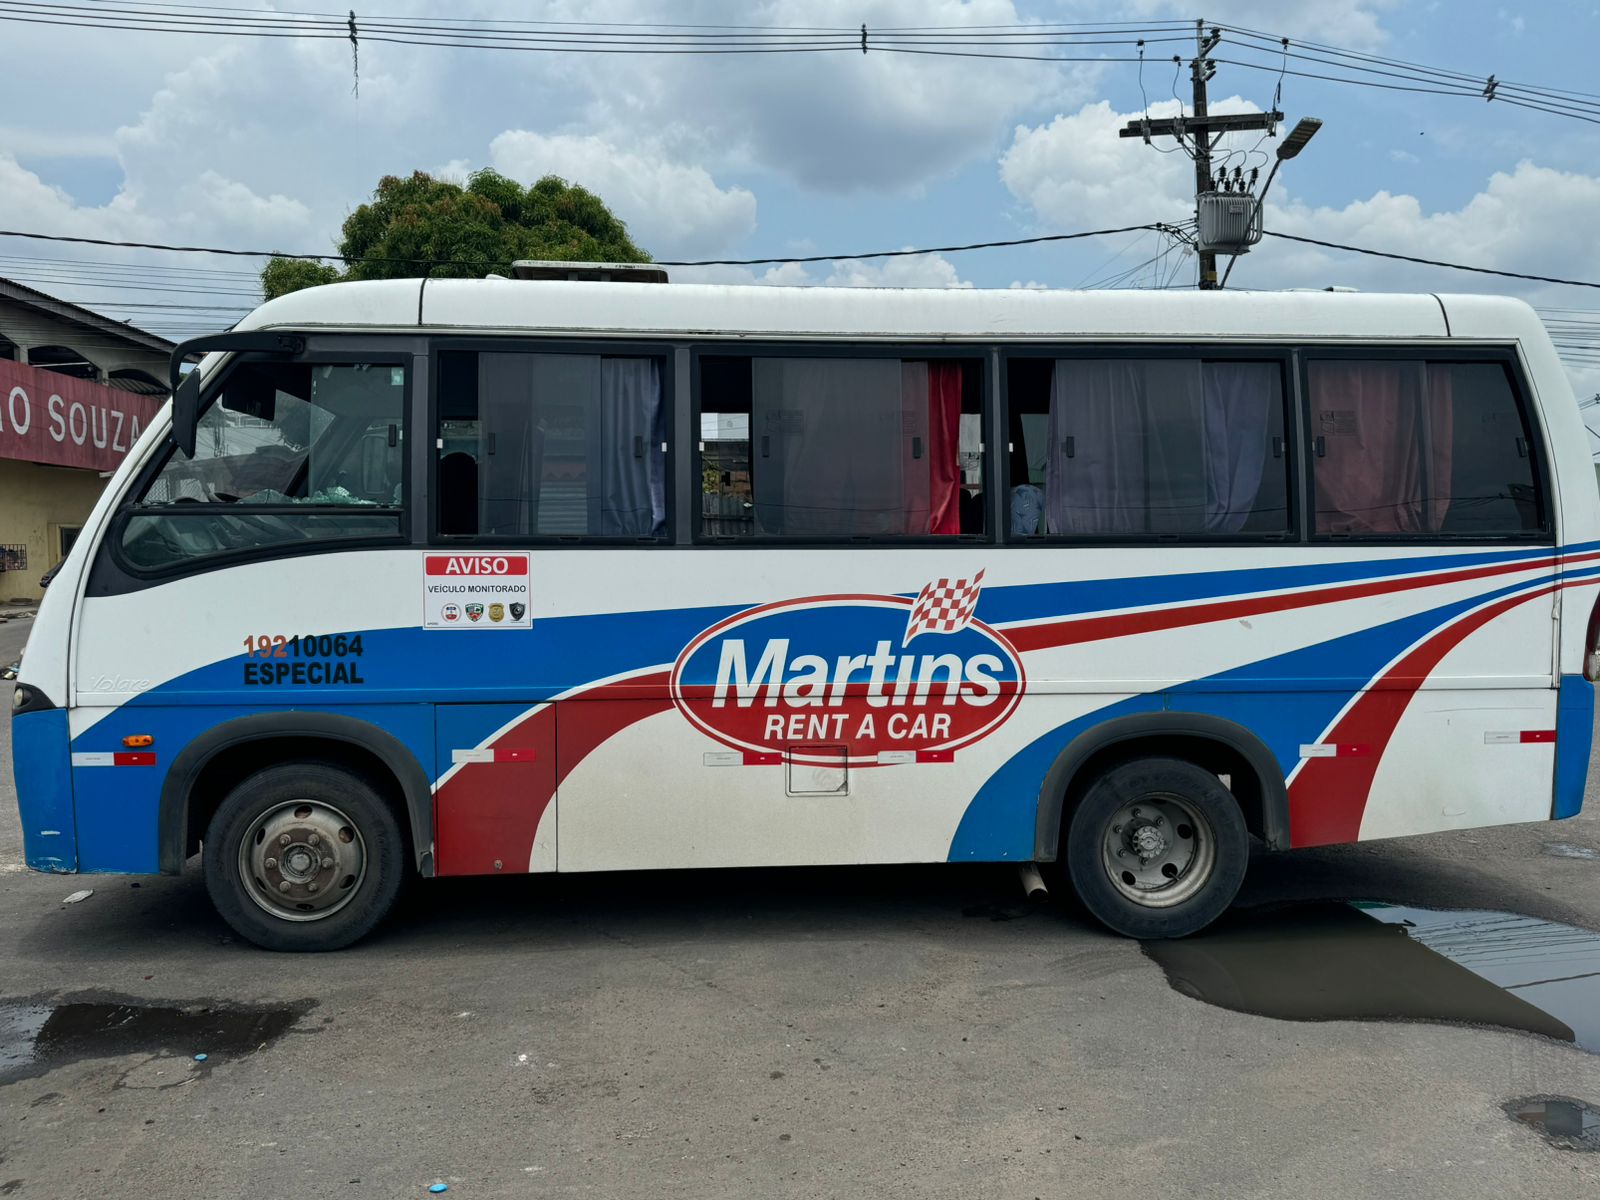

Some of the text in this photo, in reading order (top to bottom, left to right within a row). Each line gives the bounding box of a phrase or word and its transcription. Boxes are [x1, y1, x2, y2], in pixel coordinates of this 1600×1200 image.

[0, 386, 140, 452] O SOUZA
[445, 557, 509, 574] AVISO
[428, 584, 526, 593] VEÍCULO MONITORADO
[243, 634, 364, 658] 19210064
[243, 662, 364, 685] ESPECIAL
[712, 638, 1005, 708] Martins
[764, 713, 951, 740] RENT A CAR
